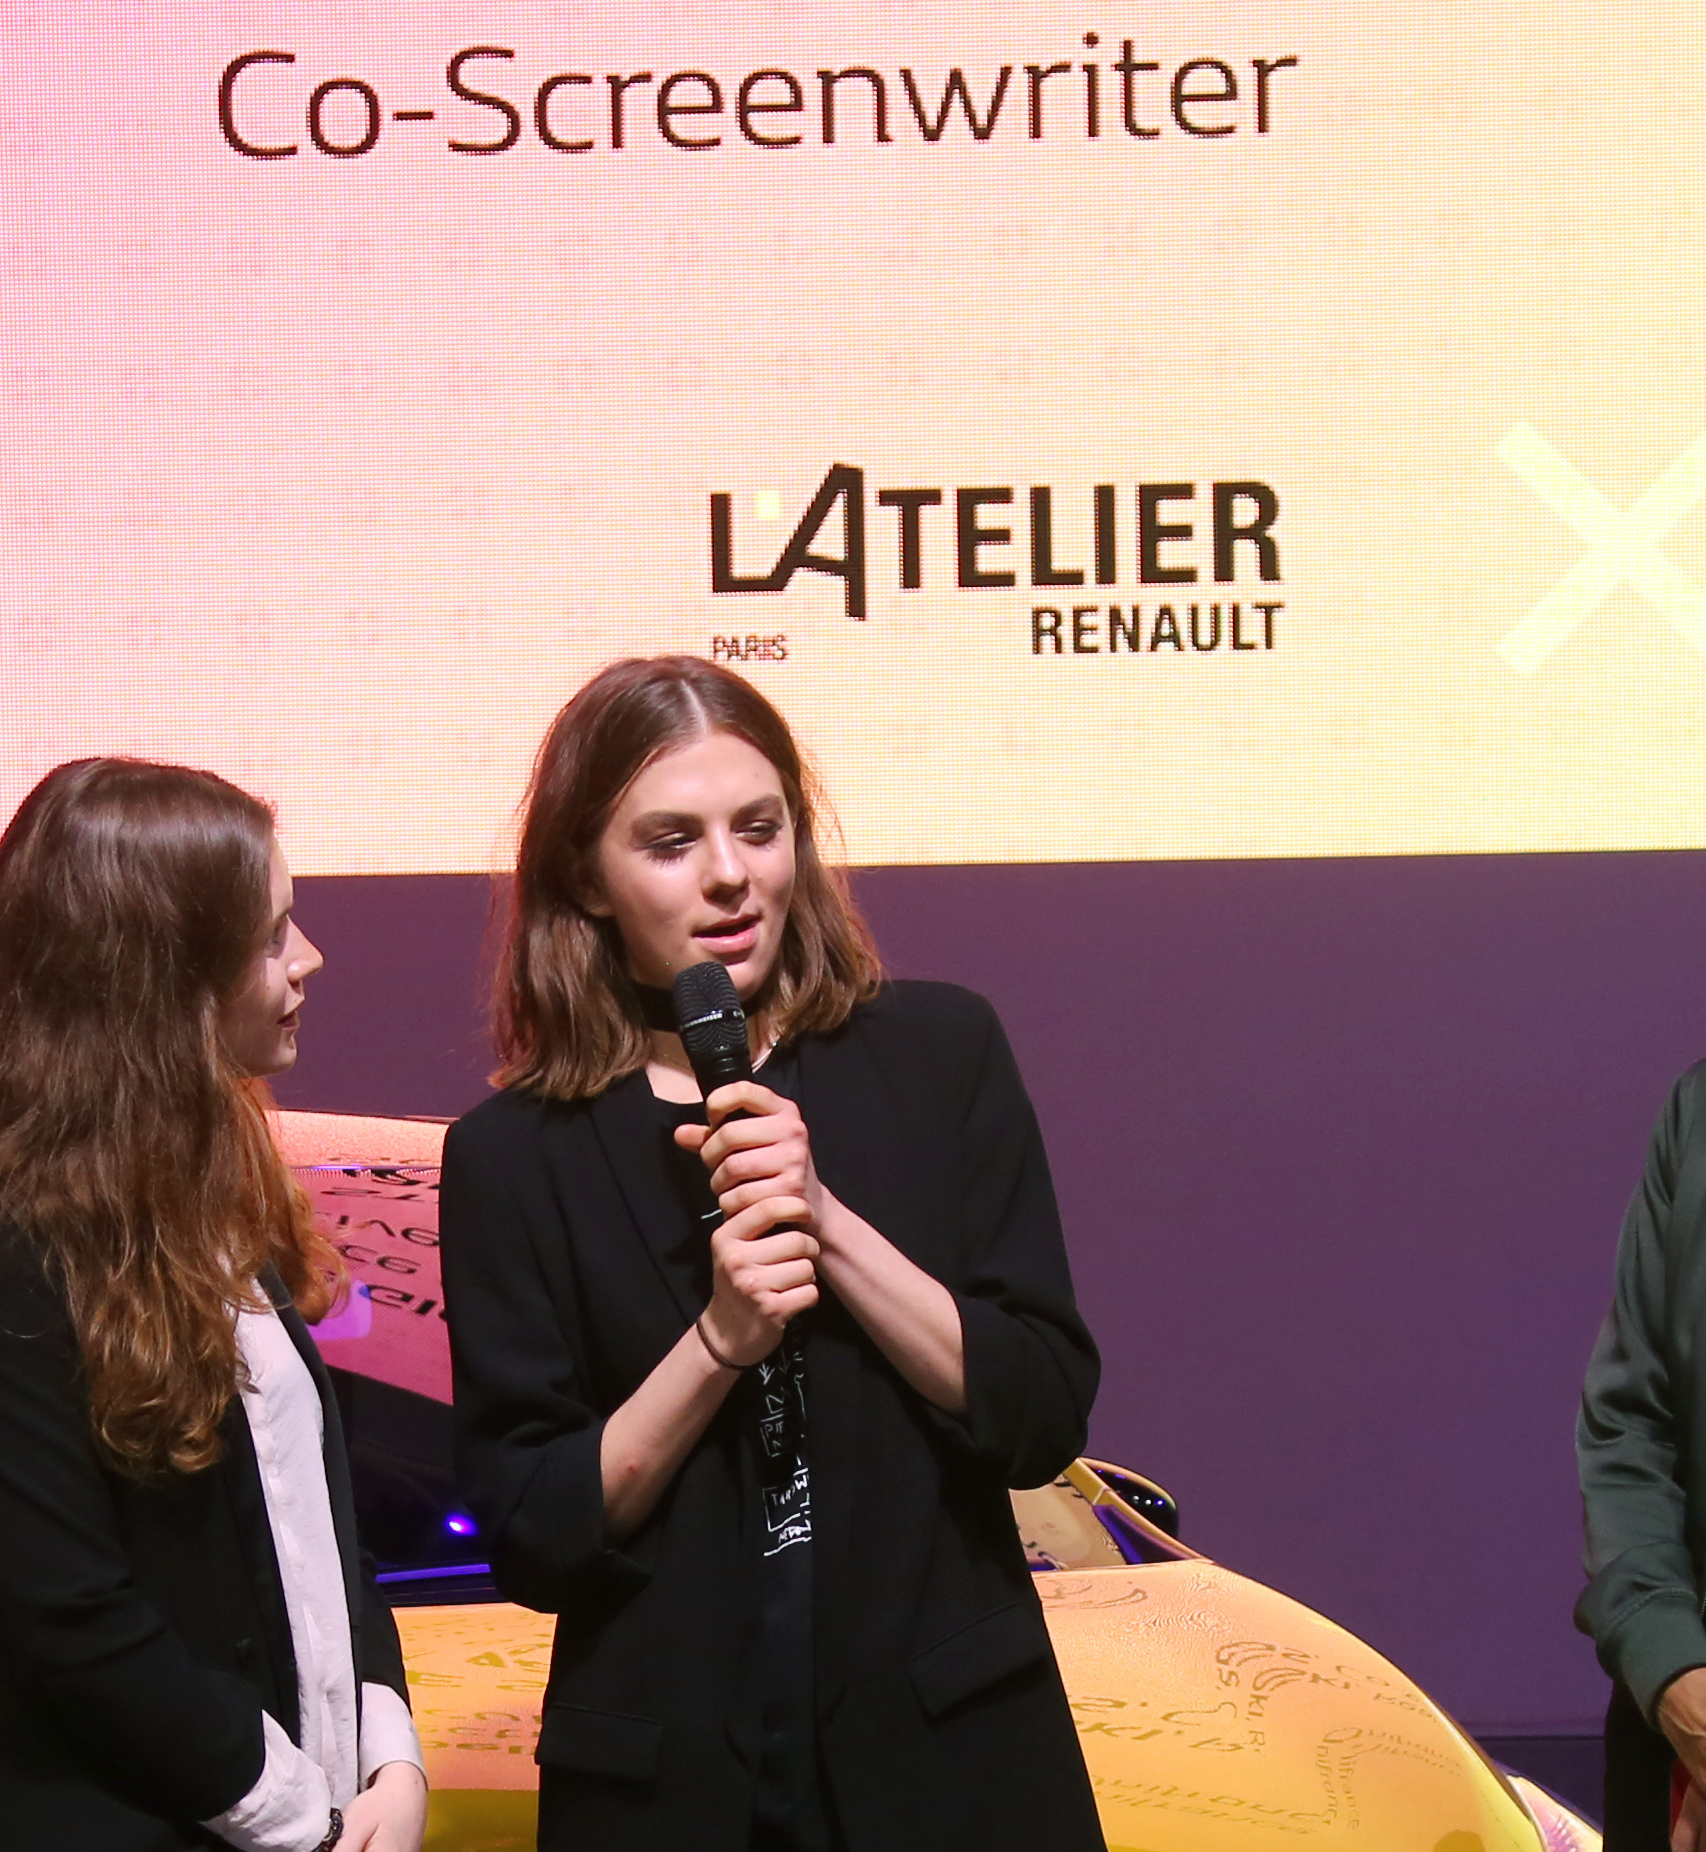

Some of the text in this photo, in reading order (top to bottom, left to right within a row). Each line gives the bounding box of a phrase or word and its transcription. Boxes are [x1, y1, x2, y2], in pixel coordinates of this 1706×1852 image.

[217, 31, 1298, 160] Co-Screenwriter
[711, 634, 789, 664] PARIS
[1031, 603, 1283, 655] RENAULT
